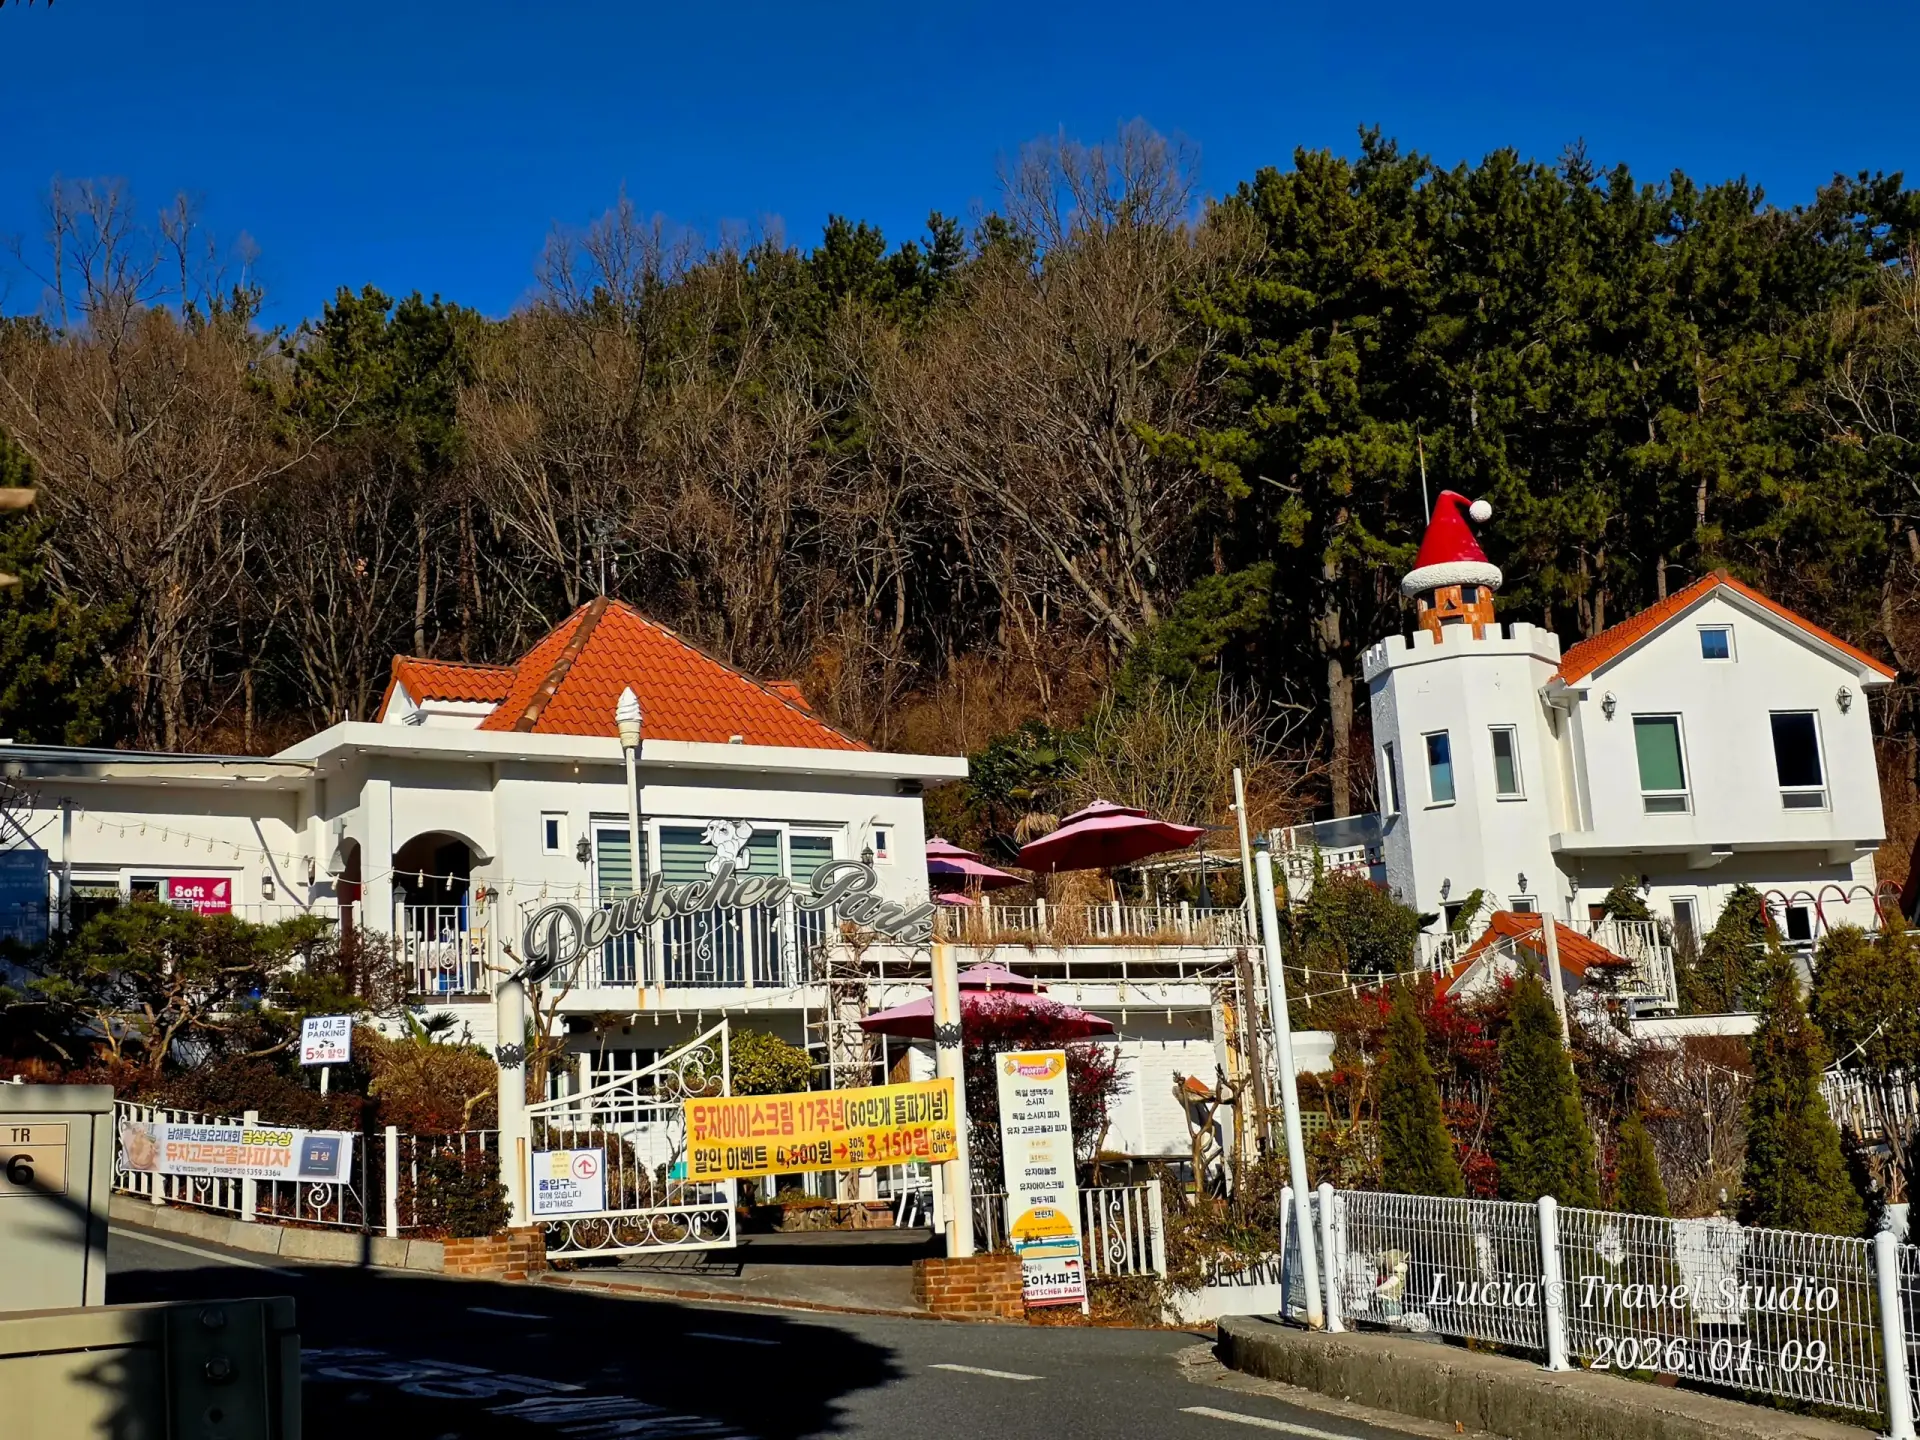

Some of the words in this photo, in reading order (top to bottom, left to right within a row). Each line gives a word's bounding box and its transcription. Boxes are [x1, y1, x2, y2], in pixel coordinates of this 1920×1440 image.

[174, 885, 205, 898] Soft
[523, 860, 793, 983] Deutscher
[794, 859, 936, 945] Park
[307, 1030, 346, 1038] PARKING
[306, 1048, 325, 1060] 5%
[327, 1048, 346, 1059] 할인
[1014, 1089, 1028, 1097] 독일
[1025, 1097, 1045, 1106] 소시지
[693, 1101, 794, 1140] 유자아이스크림
[894, 1088, 949, 1125] 돌파기념)
[1012, 1112, 1026, 1121] 독일
[1026, 1111, 1046, 1120] 소시지
[1047, 1110, 1060, 1119] 피자
[11, 1128, 31, 1143] TR
[931, 1128, 951, 1141] Take
[1006, 1126, 1020, 1135] 유자
[1021, 1125, 1053, 1134] 고르곤졸라
[1054, 1124, 1067, 1132] 피자
[241, 1129, 293, 1147] 금상수상
[848, 1136, 865, 1149] 30%
[867, 1126, 930, 1162] 3,150원
[932, 1142, 948, 1154] Out
[166, 1142, 292, 1168] 유자고르곤졸라피자
[694, 1148, 722, 1173] 할인
[726, 1145, 769, 1171] 이벤트
[776, 1139, 832, 1169] 4,500원
[849, 1150, 864, 1163] 할인
[6, 1153, 35, 1186] 6
[539, 1178, 577, 1191] 출입구는
[1019, 1180, 1065, 1191] 유자아이스크림
[538, 1192, 553, 1200] 위에
[553, 1190, 582, 1199] 있습니다
[1030, 1195, 1056, 1204] 원두커피
[1034, 1209, 1054, 1218] 브런치
[1063, 1286, 1082, 1294] PARK
